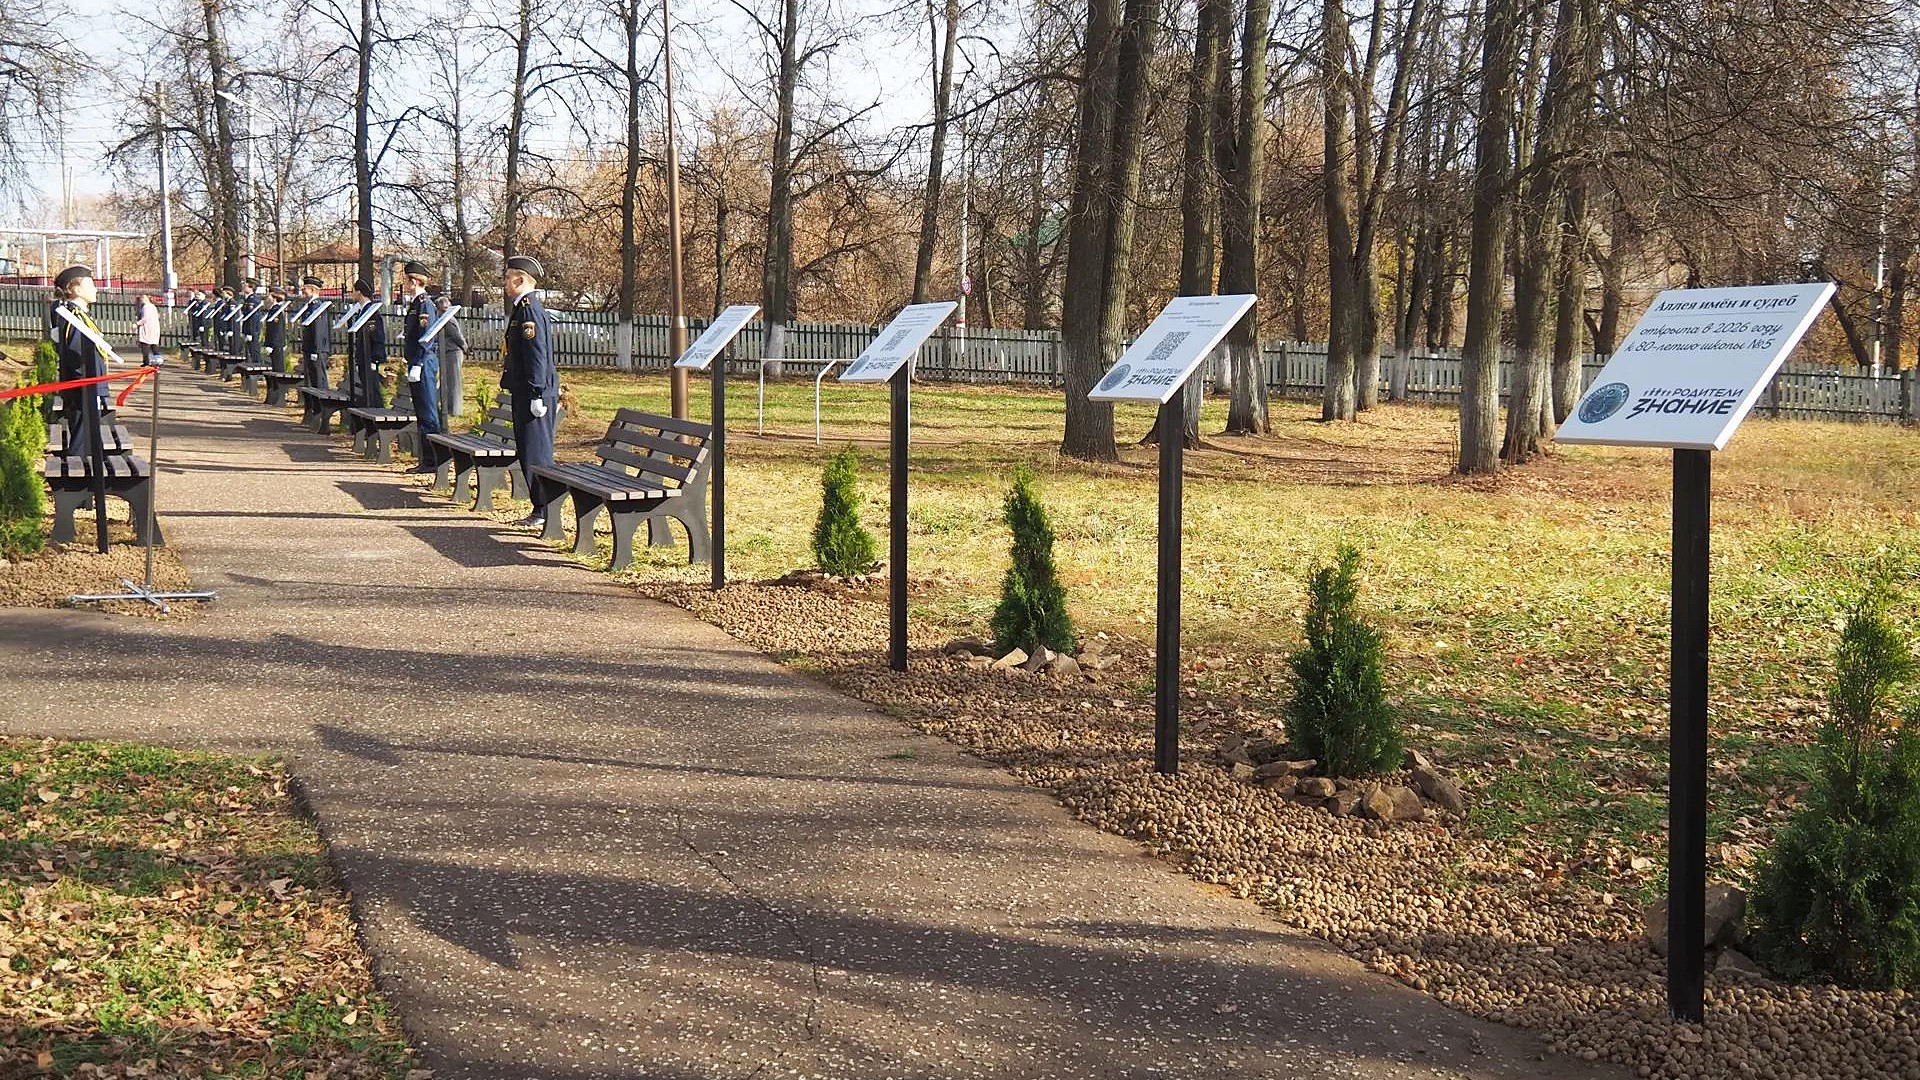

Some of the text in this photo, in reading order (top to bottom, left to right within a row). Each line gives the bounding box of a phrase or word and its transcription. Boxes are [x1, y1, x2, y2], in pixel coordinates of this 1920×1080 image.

[1655, 294, 1800, 312] Аллея имён и судеб
[1640, 322, 1784, 339] открыта в 2026 году
[1635, 340, 1700, 352] 80-летию
[1700, 338, 1746, 350] школы
[1746, 338, 1776, 350] №5
[1672, 388, 1744, 398] РОДИТЕЛИ
